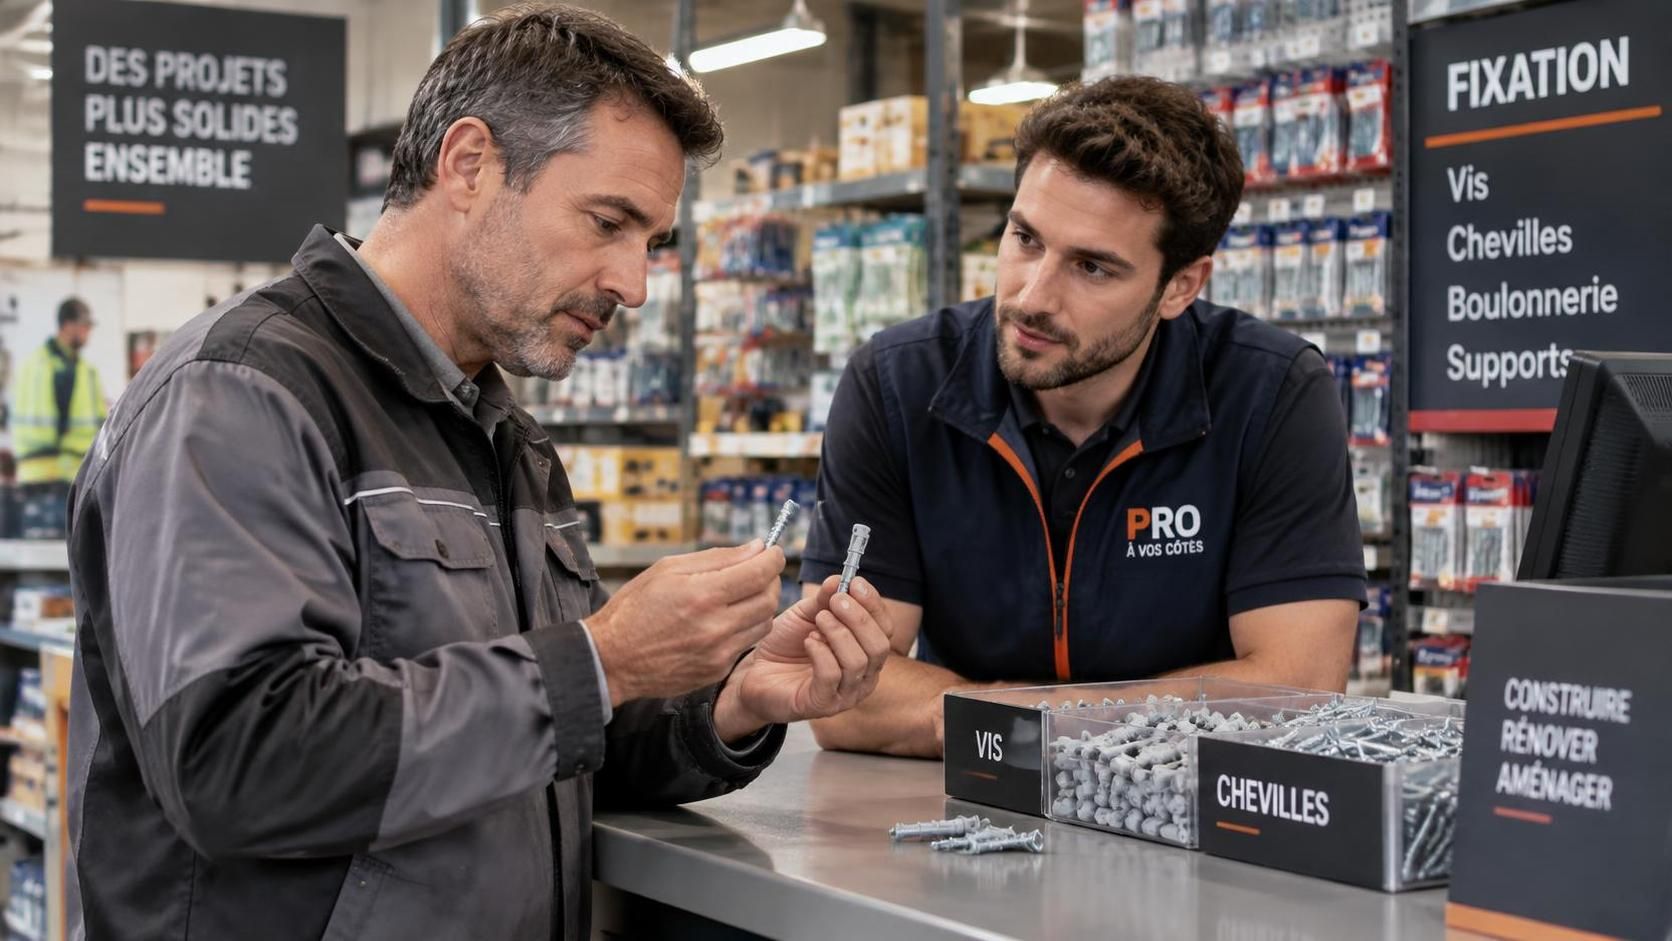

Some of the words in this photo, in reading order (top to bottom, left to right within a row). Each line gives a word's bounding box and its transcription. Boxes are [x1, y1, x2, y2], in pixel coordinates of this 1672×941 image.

[86, 46, 147, 86] DES
[156, 51, 286, 96] PROJETS
[1448, 37, 1628, 111] FIXATION
[86, 95, 166, 135] PLUS
[174, 100, 297, 144] SOLIDES
[85, 143, 250, 188] ENSEMBLE
[1448, 165, 1488, 202] Vis
[1448, 218, 1572, 261] Chevilles
[1448, 276, 1618, 321] Boulonnerie
[1448, 344, 1572, 388] Supports
[1128, 505, 1200, 540] PRO
[1138, 544, 1162, 556] VOS
[1505, 678, 1631, 723] CONSTRUIRE
[976, 731, 1002, 761] VIS
[1501, 716, 1597, 762] RÉNOVER
[1217, 775, 1329, 826] CHEVILLES
[1496, 761, 1612, 811] AMÉNAGER
